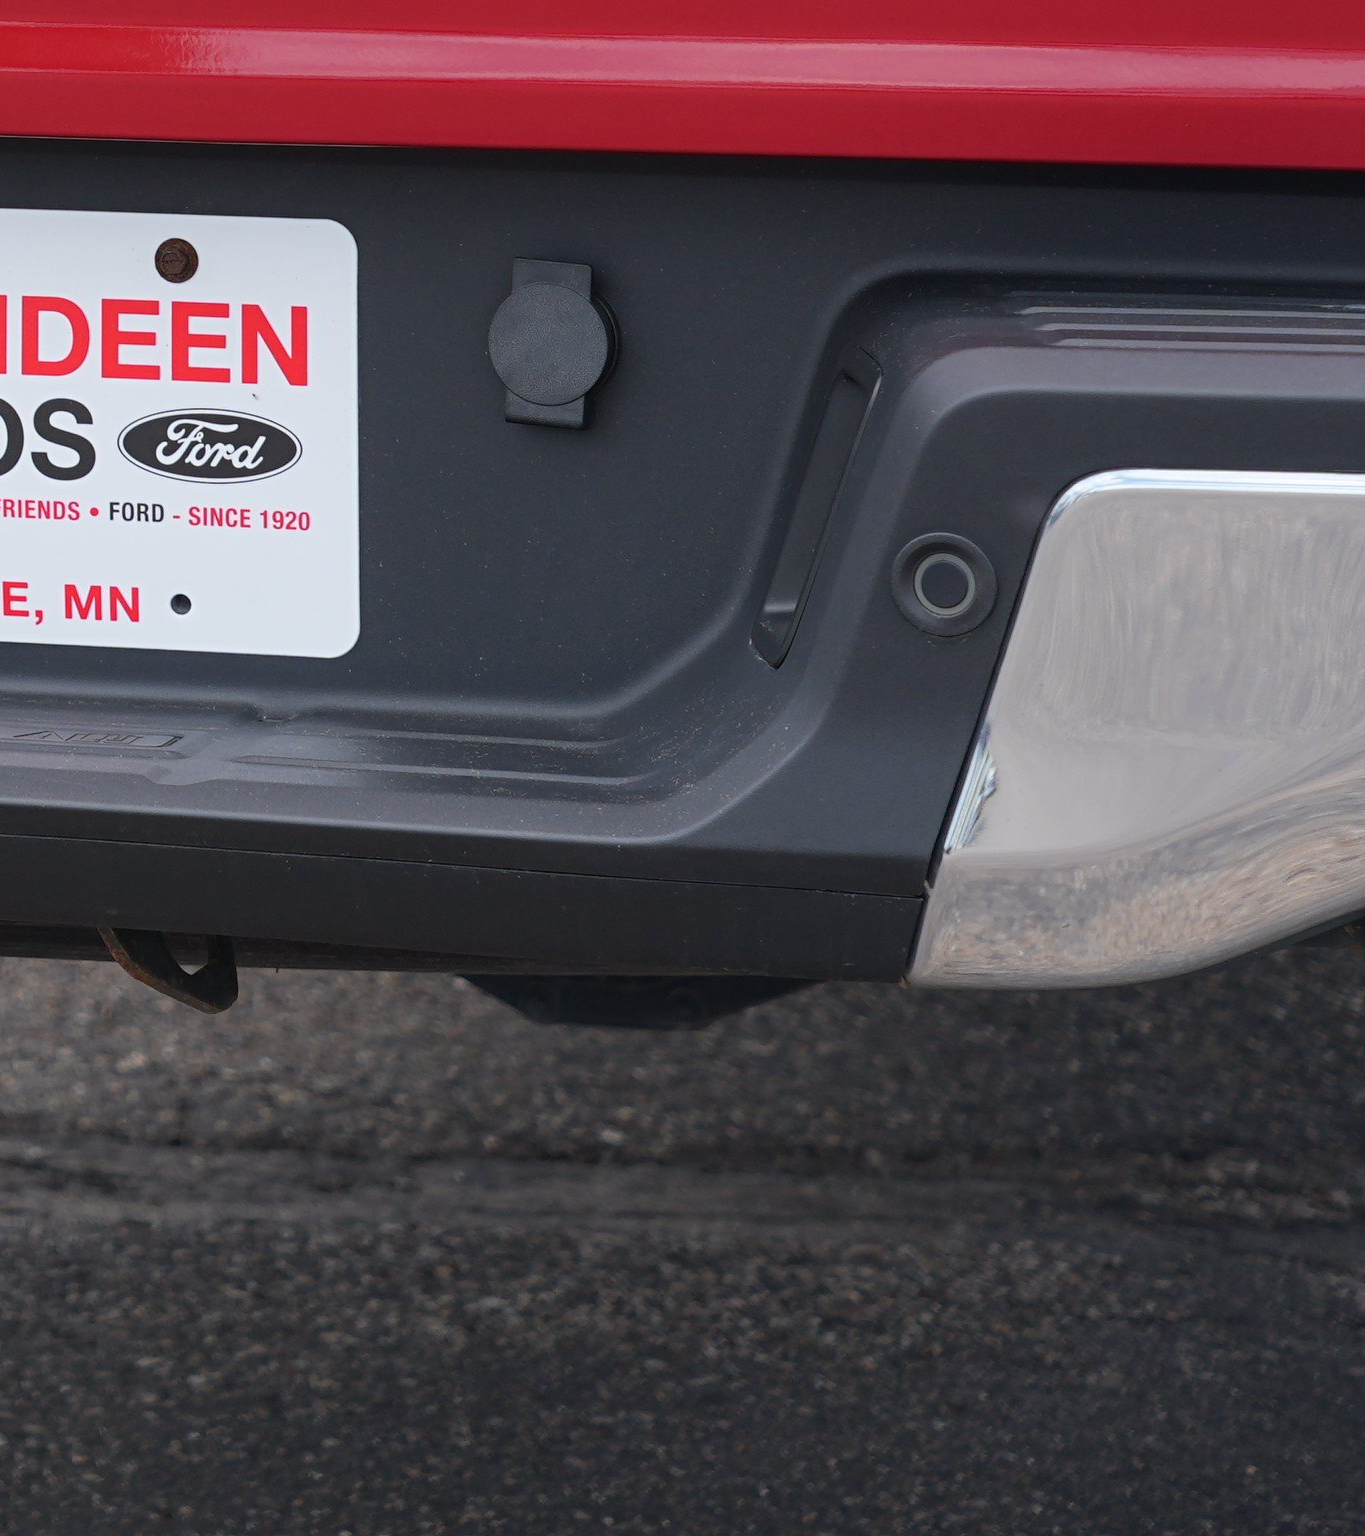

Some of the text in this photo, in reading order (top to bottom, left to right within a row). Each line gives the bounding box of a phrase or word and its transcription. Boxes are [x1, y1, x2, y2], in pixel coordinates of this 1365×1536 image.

[156, 418, 267, 470] Ford
[109, 502, 165, 524] FORD
[188, 506, 252, 530] SINCE
[259, 509, 311, 532] 1920
[64, 583, 141, 623] MN
